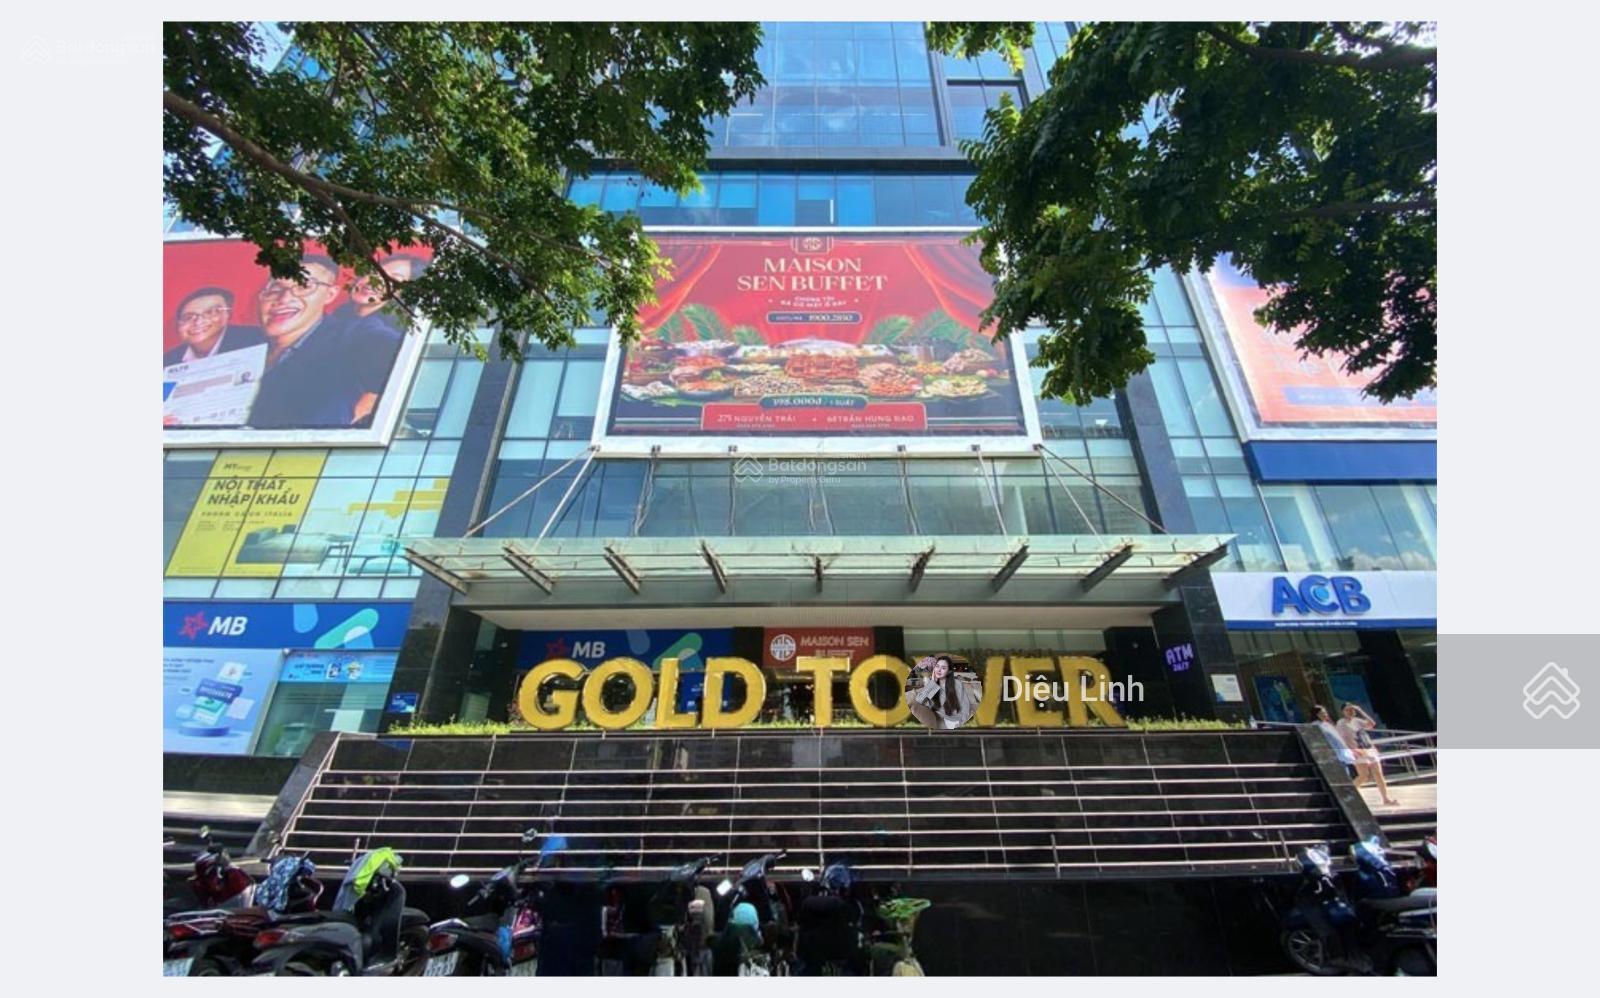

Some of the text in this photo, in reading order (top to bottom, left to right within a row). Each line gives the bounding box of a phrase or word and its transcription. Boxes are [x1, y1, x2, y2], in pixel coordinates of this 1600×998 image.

[764, 257, 862, 273] MAISON
[737, 275, 889, 291] SEN BUFFET
[213, 472, 287, 494] NỘI THẤT
[207, 490, 252, 509] NHẬP
[1271, 574, 1372, 616] ACB
[207, 615, 249, 636] MB
[571, 640, 607, 659] MB
[800, 635, 869, 647] MAISON SEN
[1165, 642, 1195, 666] ATM
[518, 653, 1128, 731] GOLD TOER
